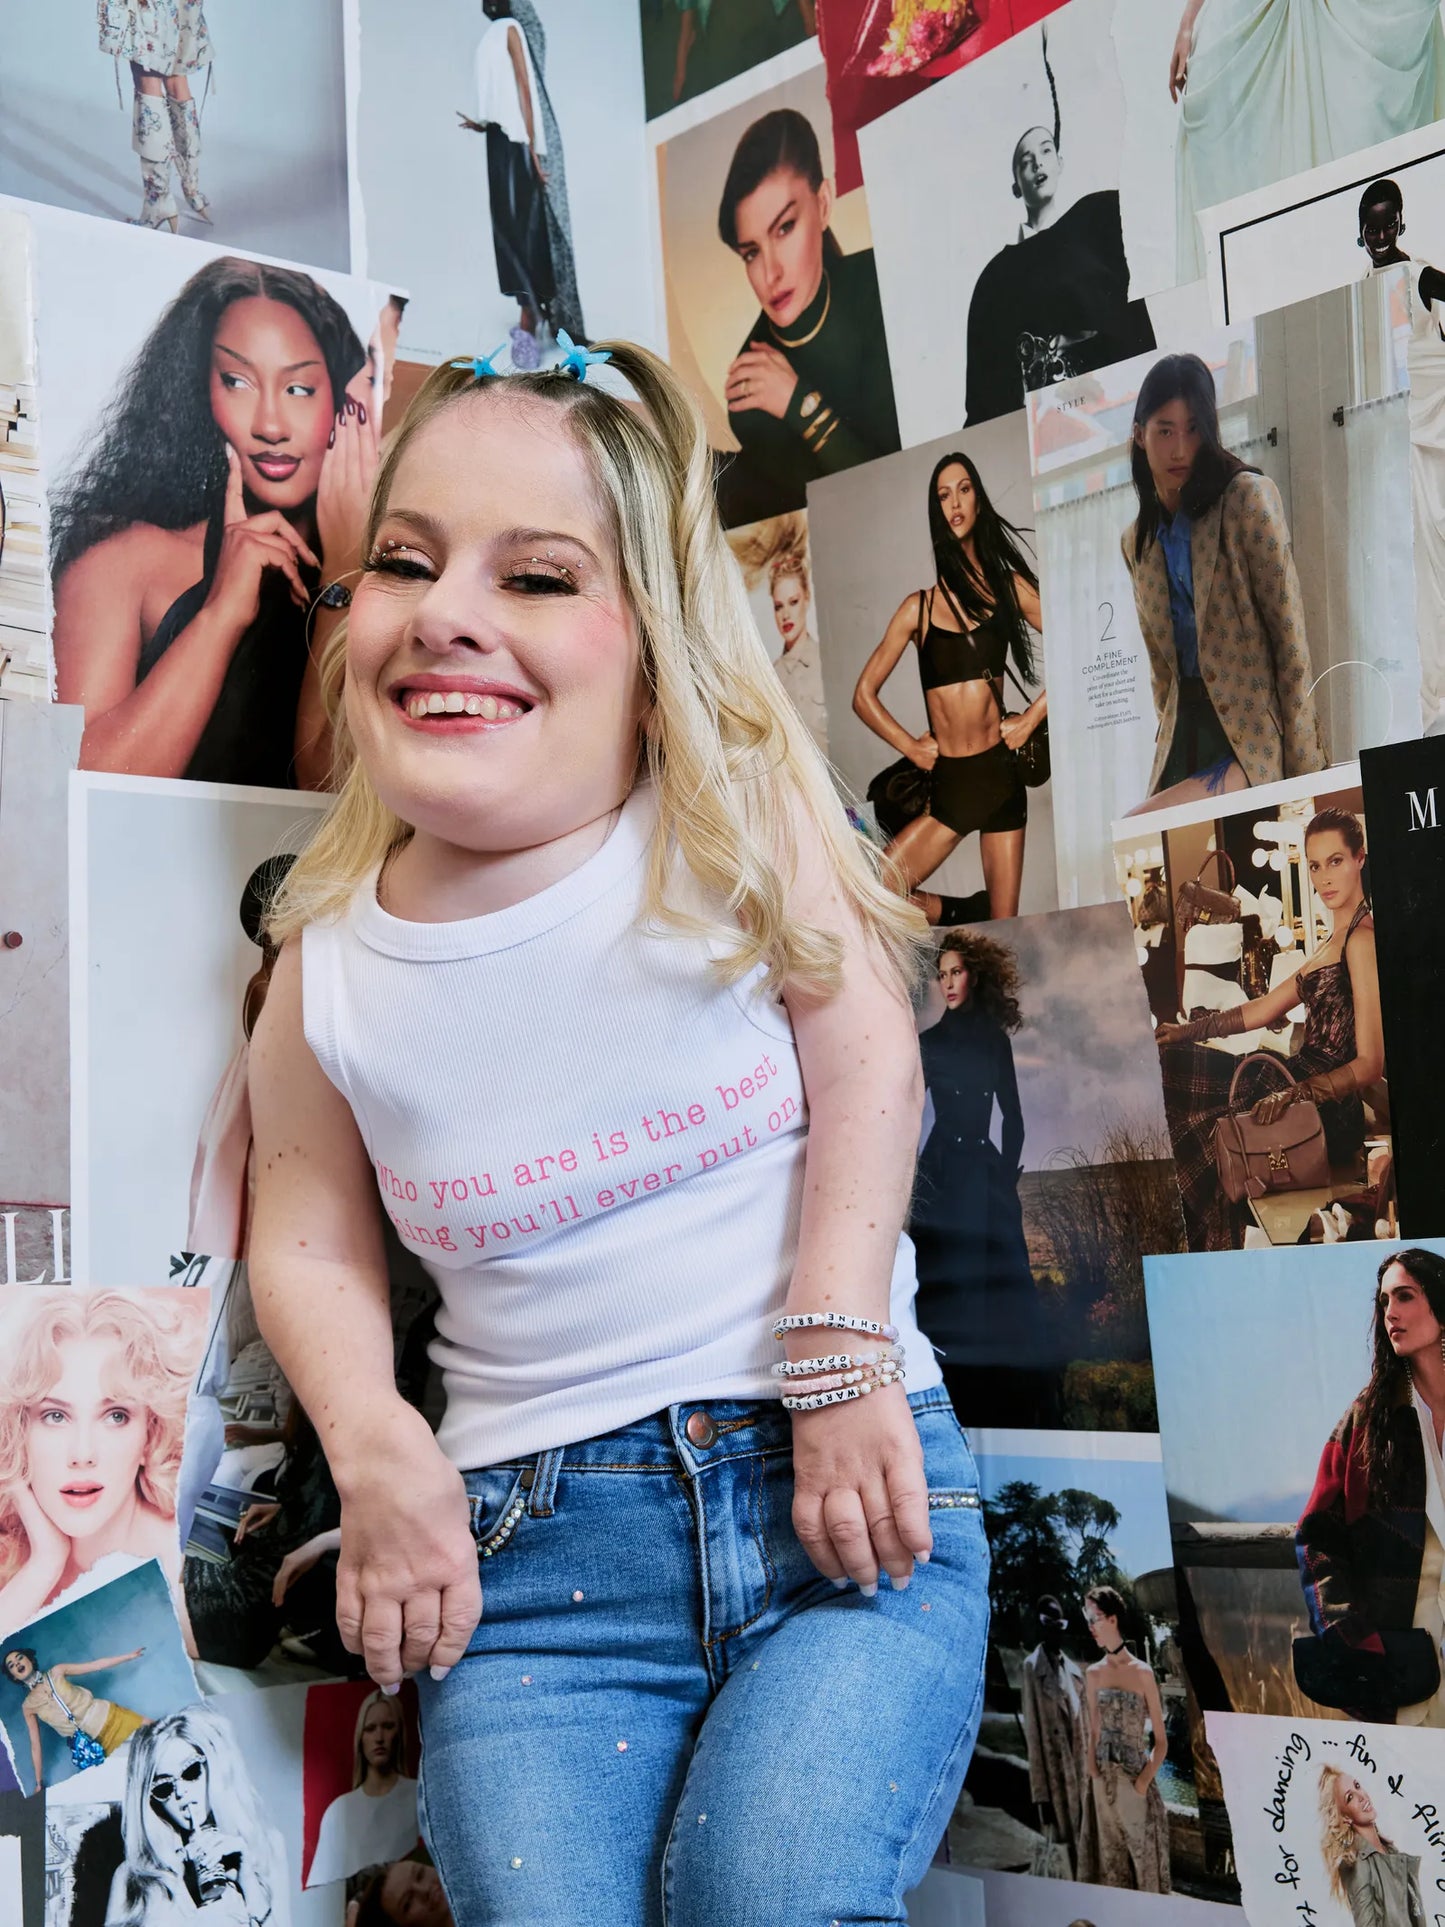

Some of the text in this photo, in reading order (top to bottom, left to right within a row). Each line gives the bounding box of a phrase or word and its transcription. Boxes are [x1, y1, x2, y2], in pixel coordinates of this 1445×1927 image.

[1056, 396, 1086, 414] STYLE
[1098, 602, 1117, 642] 2
[1081, 655, 1138, 675] COMPLEMENT
[1096, 649, 1123, 663] A FINE
[376, 1052, 778, 1210] Who you are is the best
[388, 1209, 458, 1252] hing
[465, 1194, 583, 1249] you'll
[596, 1163, 682, 1208] ever
[697, 1124, 758, 1170] put
[828, 1313, 880, 1332] SHINE
[787, 1387, 858, 1410] WARRIOR
[1346, 1733, 1377, 1774] fun
[1263, 1732, 1311, 1833] dancing
[1274, 1845, 1301, 1890] for
[1296, 1900, 1318, 1927] rt
